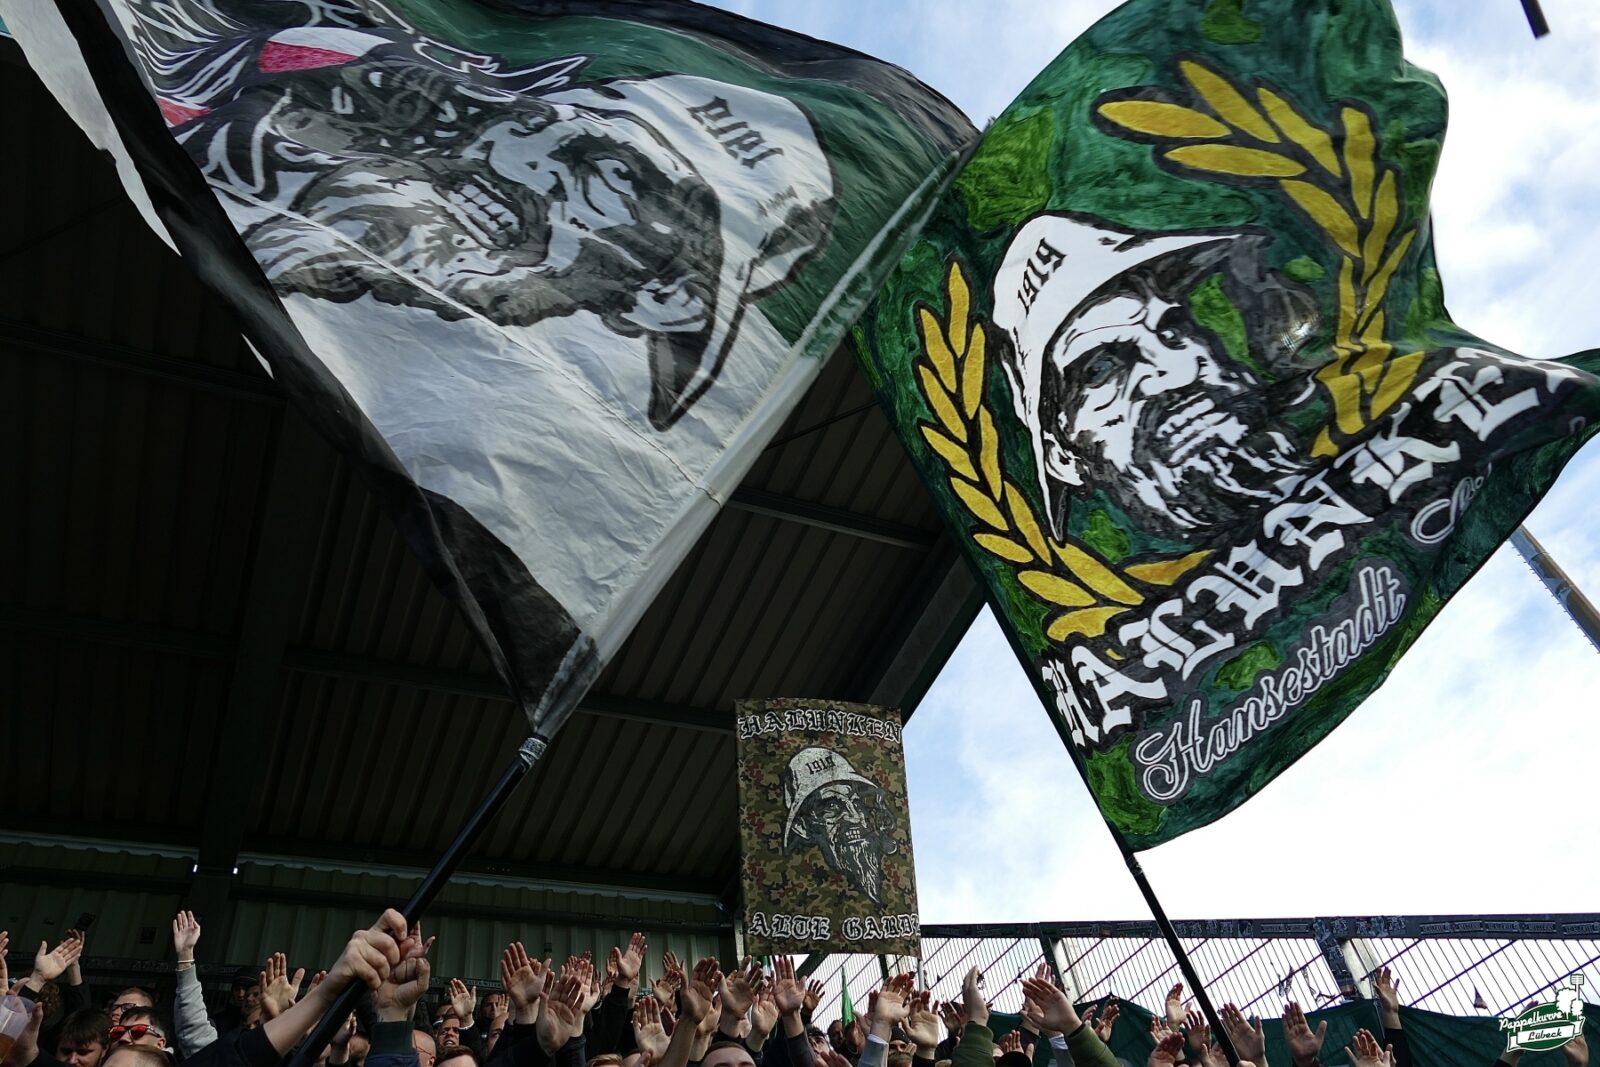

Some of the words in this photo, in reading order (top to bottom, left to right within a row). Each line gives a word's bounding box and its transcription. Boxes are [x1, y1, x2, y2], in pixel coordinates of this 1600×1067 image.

[1017, 236, 1068, 319] 1919
[1135, 565, 1406, 800] Hansestadt
[737, 708, 902, 743] HALUNKEN
[805, 755, 836, 775] 1919
[749, 911, 832, 941] ALTE
